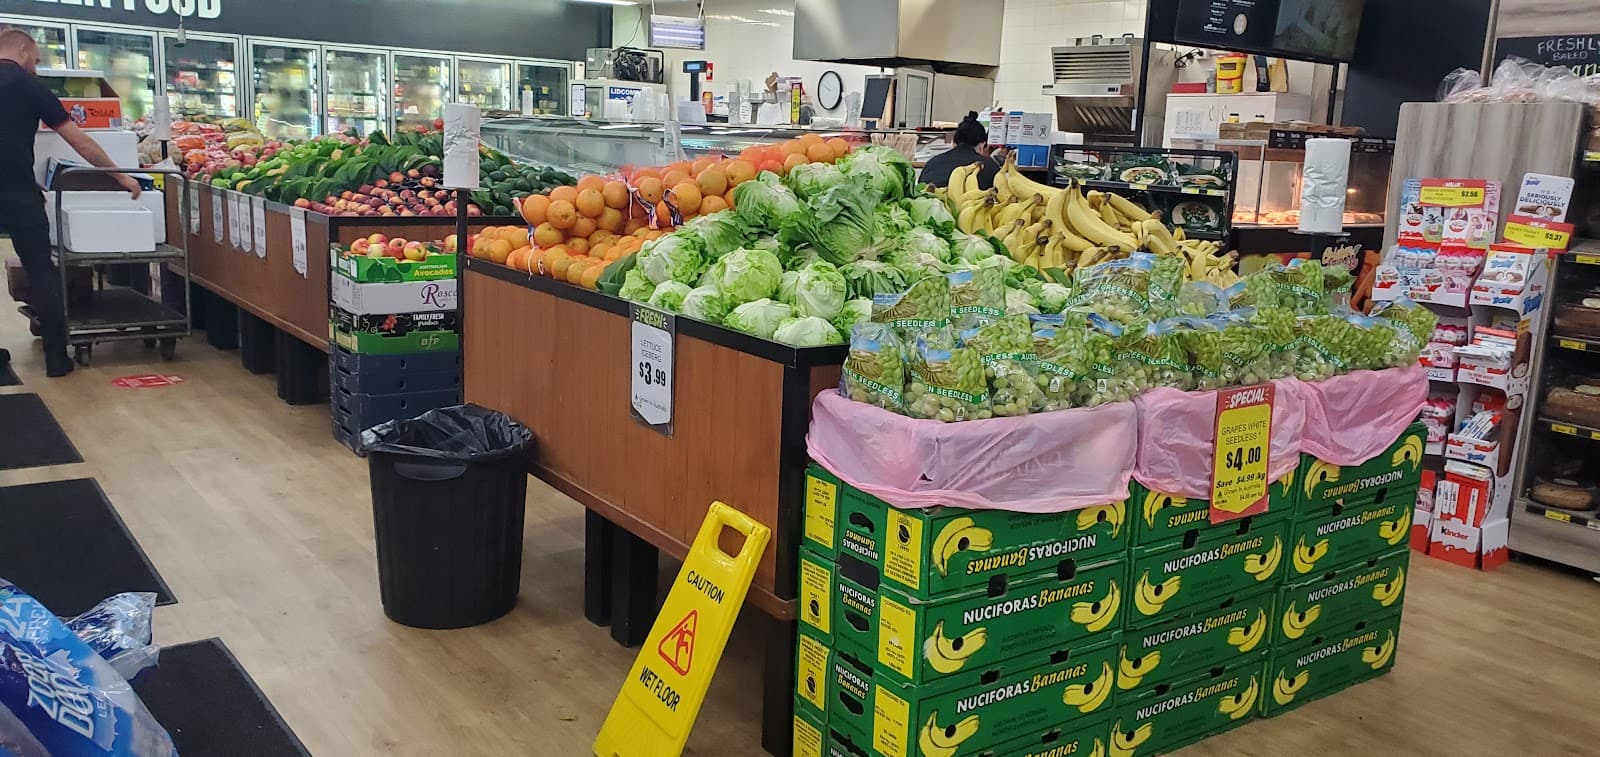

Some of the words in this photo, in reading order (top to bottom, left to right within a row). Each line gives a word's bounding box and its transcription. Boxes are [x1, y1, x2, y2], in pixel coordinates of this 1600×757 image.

[1519, 196, 1566, 207] DELICIOUSLY
[1527, 192, 1562, 201] SERIOUSLY
[414, 269, 454, 277] Avocados
[640, 308, 664, 326] FRESH
[959, 306, 1000, 316] SEEDLESS
[896, 320, 936, 328] SEEDLESS
[641, 339, 662, 353] LETTUCE
[640, 361, 666, 387] $3.99
[858, 376, 899, 400] SEEDLESS
[936, 388, 973, 402] SEEDLESS
[1229, 388, 1265, 409] SPECIAL
[1222, 424, 1247, 436] GRAPES
[1248, 420, 1267, 431] WHITE
[1225, 432, 1257, 446] SEEDLESS
[1226, 447, 1261, 471] $4.00
[1216, 480, 1233, 488] Save
[1322, 479, 1361, 499] Bananas
[1360, 470, 1403, 490] NUCIFORAS
[1168, 509, 1209, 528] ananas
[1316, 514, 1361, 537] NUCIFORAS
[1360, 505, 1396, 525] Bananas
[842, 538, 879, 561] NUCIFORAS
[845, 529, 876, 551] Bananas
[1029, 534, 1097, 561] NUCIFORAS
[967, 548, 1029, 575] Bananas
[1163, 548, 1220, 574] NUCIFORAS
[1220, 536, 1263, 560] Bananas
[687, 570, 725, 605] CAUTION
[839, 583, 875, 608] NUCIFORAS
[1307, 579, 1354, 603] NUCIFORAS
[1354, 567, 1389, 588] Bananas
[842, 593, 872, 616] Bananas
[963, 595, 1038, 625] NUCIFORAS
[1037, 581, 1095, 608] Bananas
[1142, 622, 1203, 648] NUCIFORAS
[1203, 608, 1248, 633] Bananas
[1296, 642, 1342, 668] NUCIFORAS
[1341, 630, 1379, 652] Bananas
[639, 665, 658, 690] WET
[654, 678, 681, 713] FLOOR
[835, 663, 869, 692] NUCIFORAS
[838, 674, 866, 700] Bananas
[956, 679, 1030, 714] NUCIFORAS
[1029, 663, 1088, 692] Bananas
[1136, 691, 1194, 721] NUCIFORAS
[1193, 676, 1239, 703] Bananas
